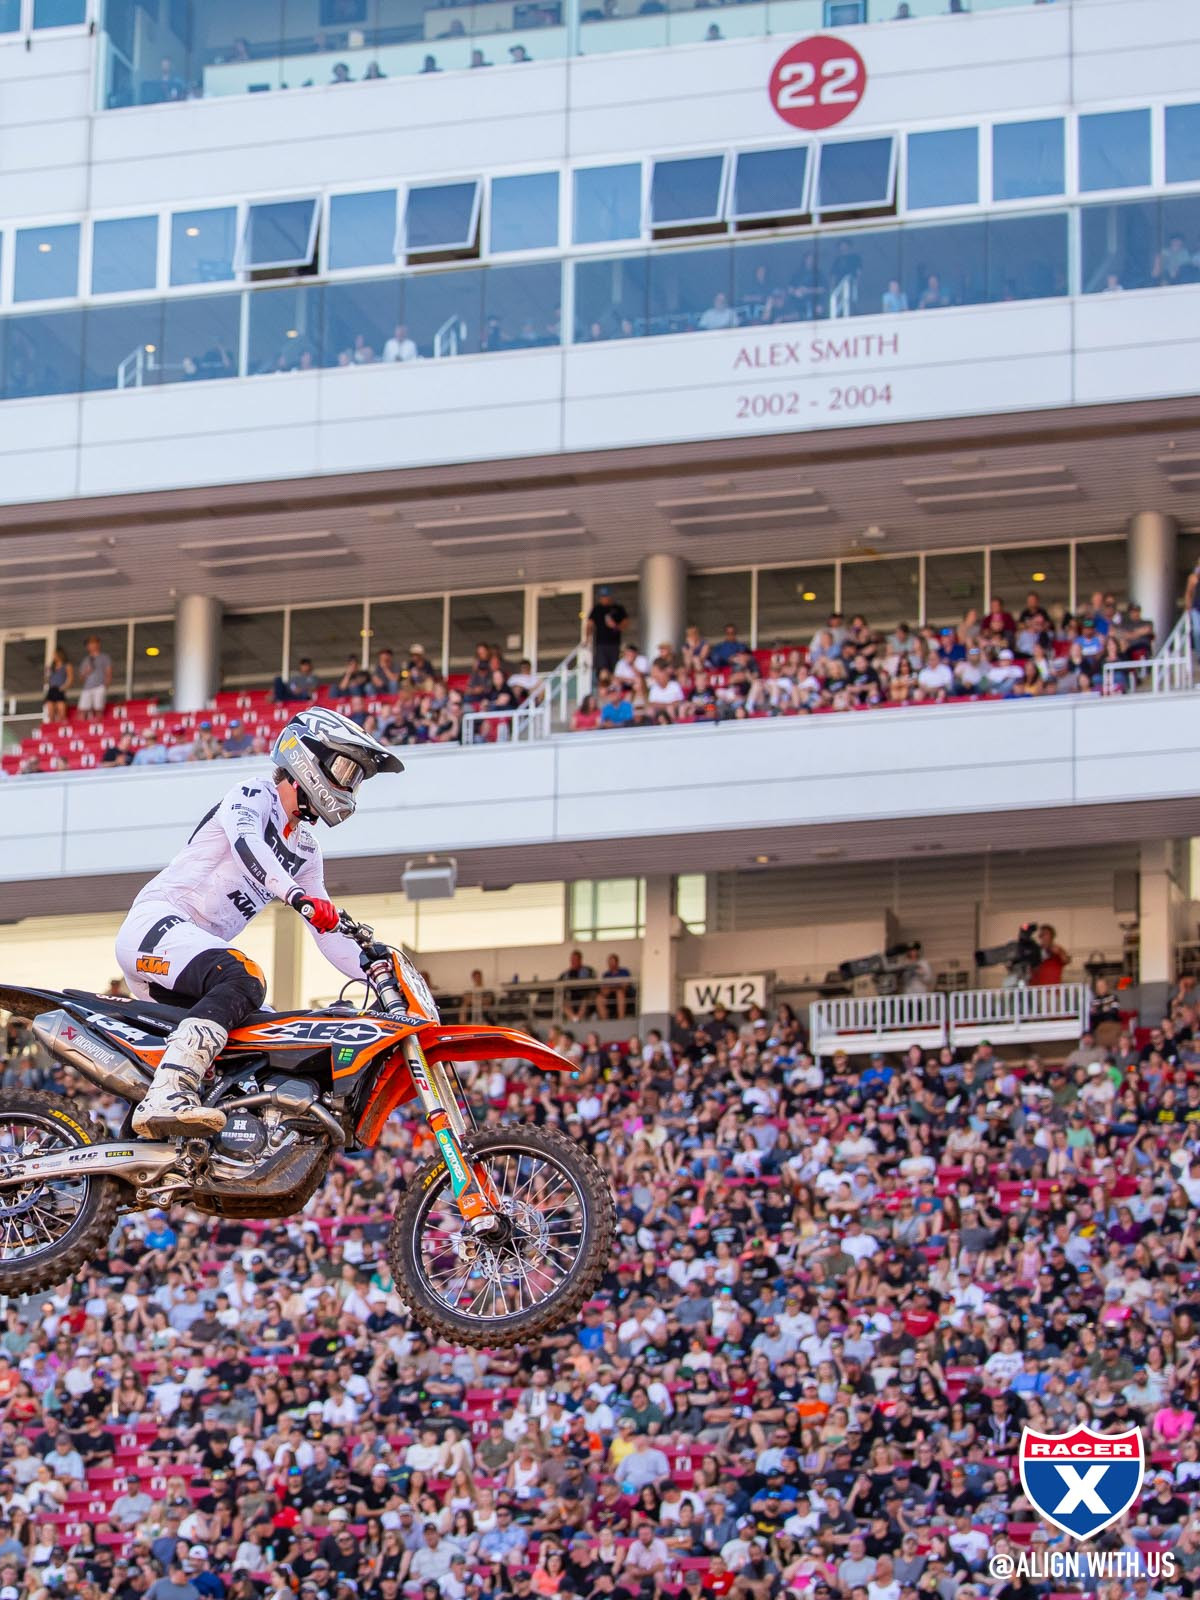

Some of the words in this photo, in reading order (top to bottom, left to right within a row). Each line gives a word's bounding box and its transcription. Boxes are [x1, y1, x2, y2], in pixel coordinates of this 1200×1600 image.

[777, 57, 859, 109] 22
[733, 341, 800, 369] ALEX
[810, 332, 900, 363] SMITH
[736, 392, 801, 419] 2002
[827, 384, 893, 411] 2004
[289, 749, 343, 813] synchrony
[227, 889, 257, 921] KTM
[136, 955, 170, 976] KTM
[695, 982, 755, 1008] W12
[369, 1010, 420, 1025] synchrony
[441, 1143, 466, 1183] MOTOREX
